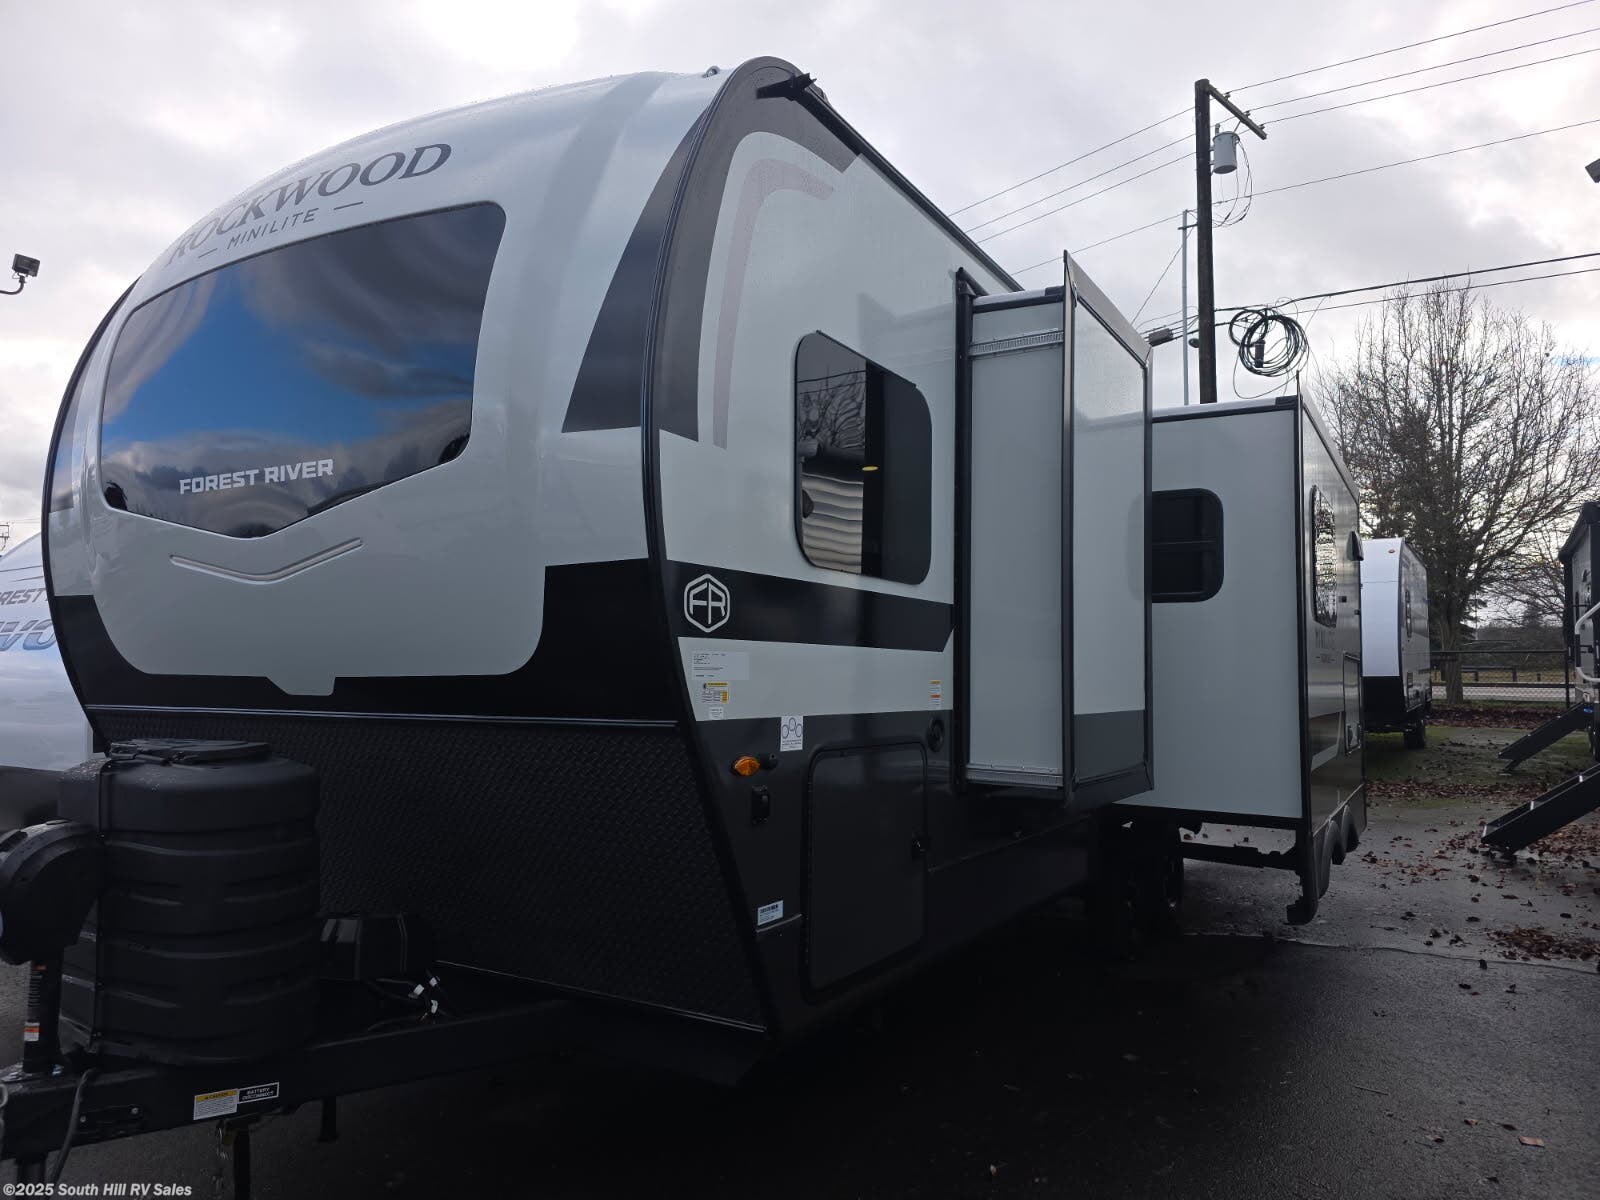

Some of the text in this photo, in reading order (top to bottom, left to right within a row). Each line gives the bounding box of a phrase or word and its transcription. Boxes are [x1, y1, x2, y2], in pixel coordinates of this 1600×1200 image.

[165, 143, 452, 268] ROCKWOOD
[227, 207, 320, 250] MINILITE
[179, 458, 334, 495] FOREST RIVER
[0, 587, 47, 606] REST
